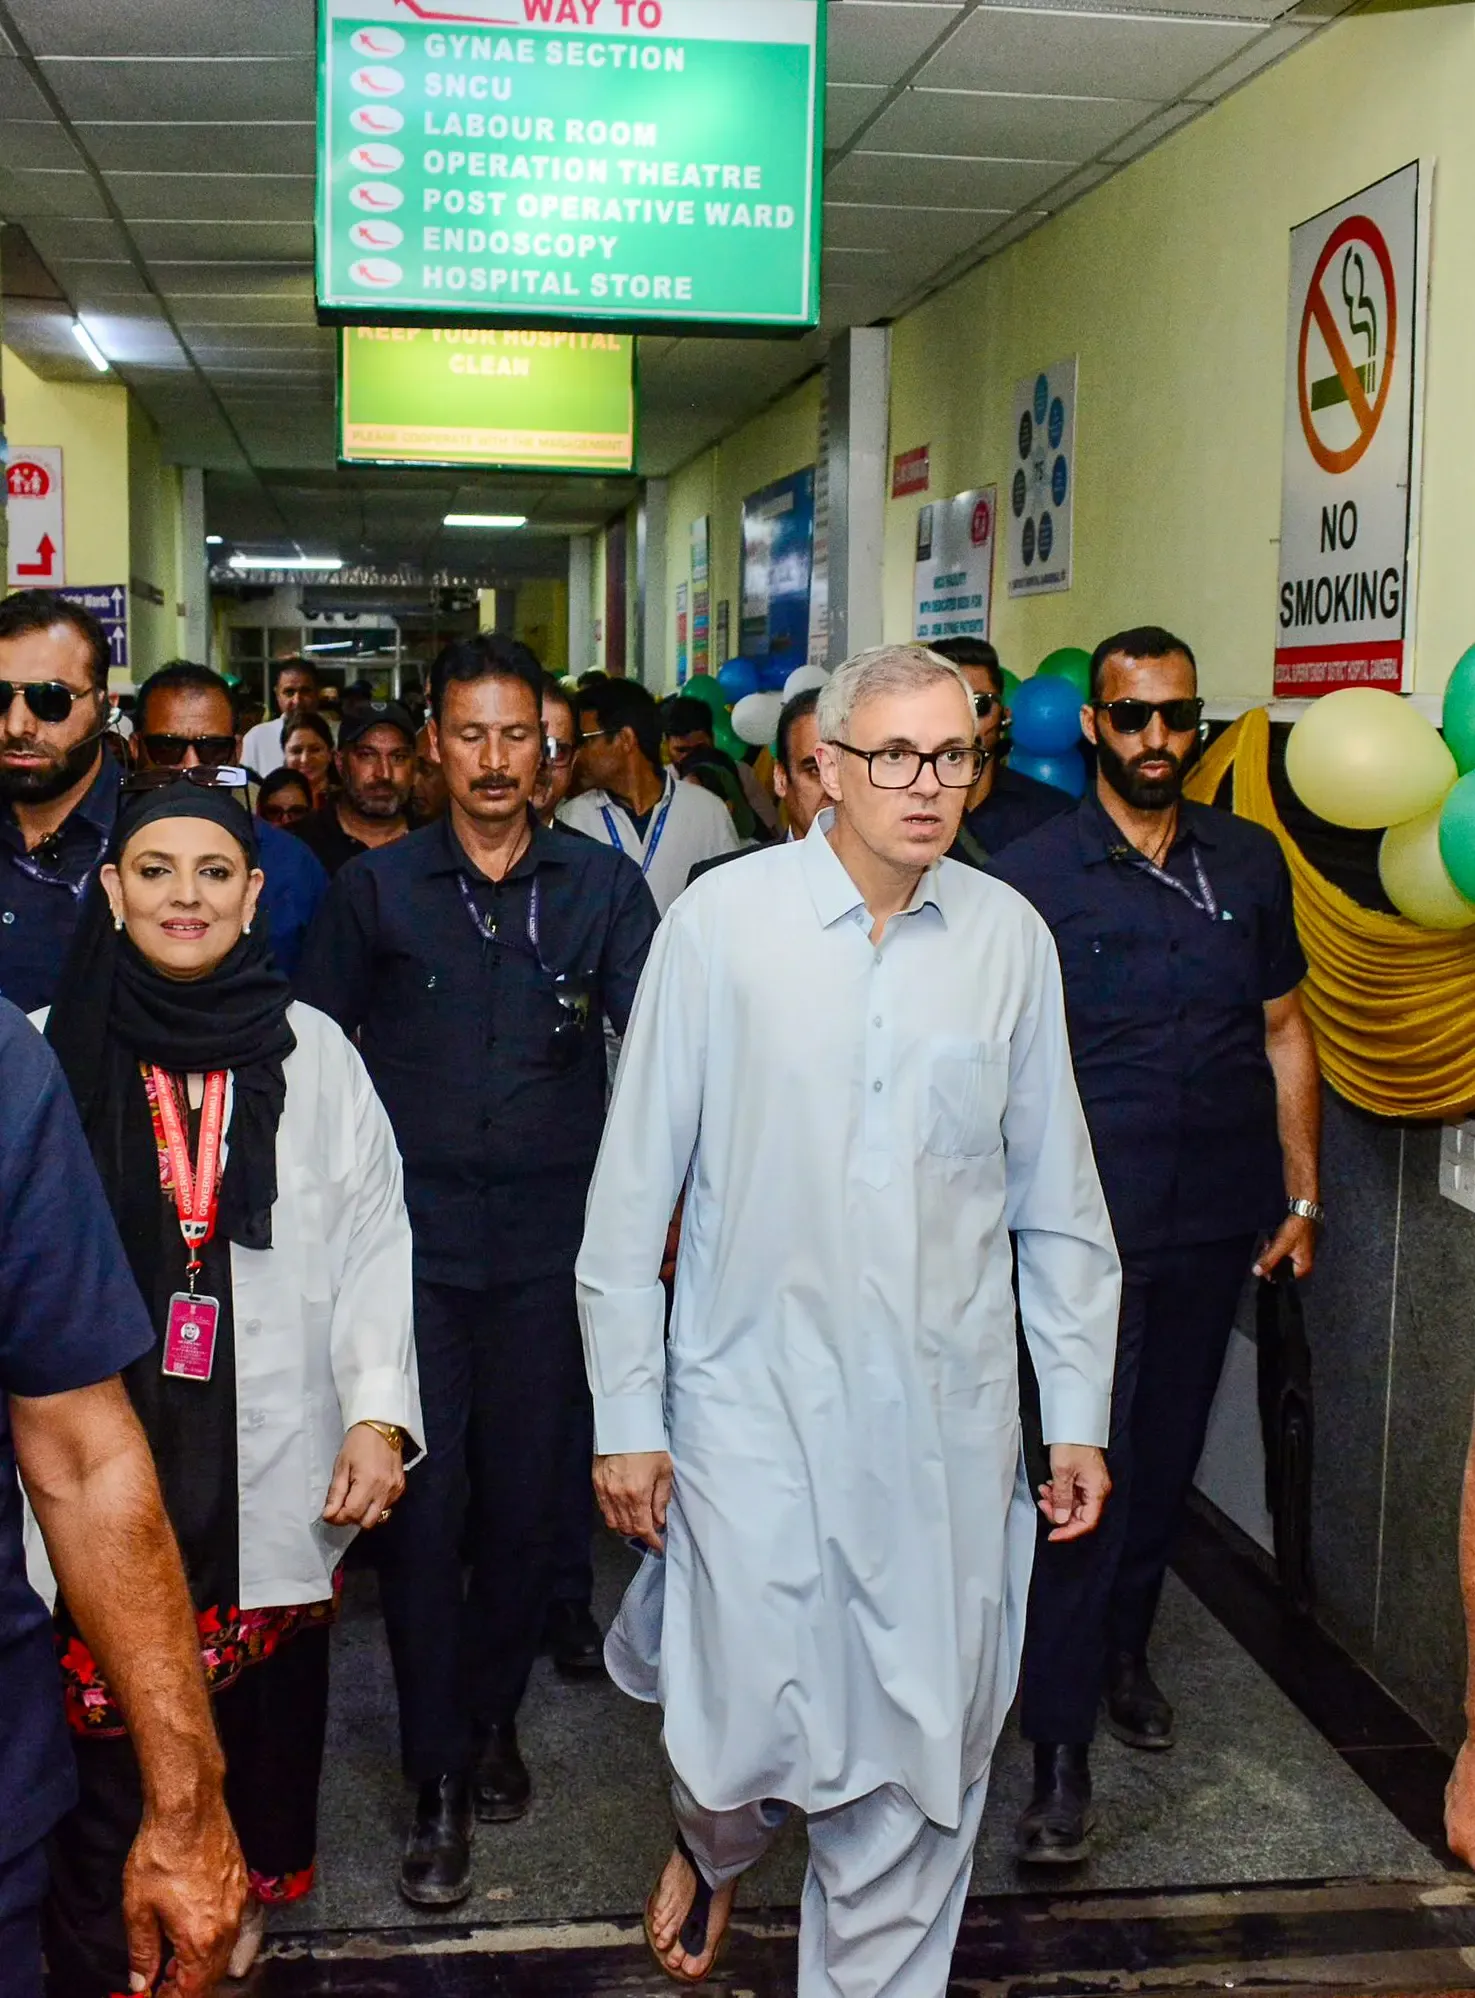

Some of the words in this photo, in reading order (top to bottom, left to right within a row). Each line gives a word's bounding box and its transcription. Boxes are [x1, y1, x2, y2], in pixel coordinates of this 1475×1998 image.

[523, 0, 602, 25] WAY
[614, 0, 663, 29] TO
[425, 35, 534, 65] GYNAE
[547, 41, 685, 71] SECTION
[425, 73, 511, 100] SNCU
[425, 111, 554, 141] LABOUR
[566, 119, 657, 146] ROOM
[424, 150, 607, 183] OPERATION
[619, 160, 761, 189] THEATRE
[423, 189, 506, 217] POST
[518, 194, 694, 225] OPERATIVE
[705, 203, 794, 229] WARD
[424, 227, 617, 259] ENDOSCOPY
[423, 266, 579, 297] HOSPITAL
[591, 272, 693, 300] STORE
[357, 327, 421, 341] KEEP
[432, 328, 497, 346] YOUR
[503, 330, 621, 351] HOSPITAL
[449, 354, 531, 377] CLEAN
[1321, 500, 1358, 553] NO
[1279, 567, 1400, 628] SMOKING
[211, 1074, 221, 1093] AND
[163, 1096, 177, 1128] JAMMU
[207, 1096, 218, 1129] JAMMU
[169, 1130, 181, 1144] OF
[205, 1132, 215, 1145] OF
[174, 1145, 192, 1215] GOVERNMENT
[199, 1147, 213, 1216] GOVERNMENT
